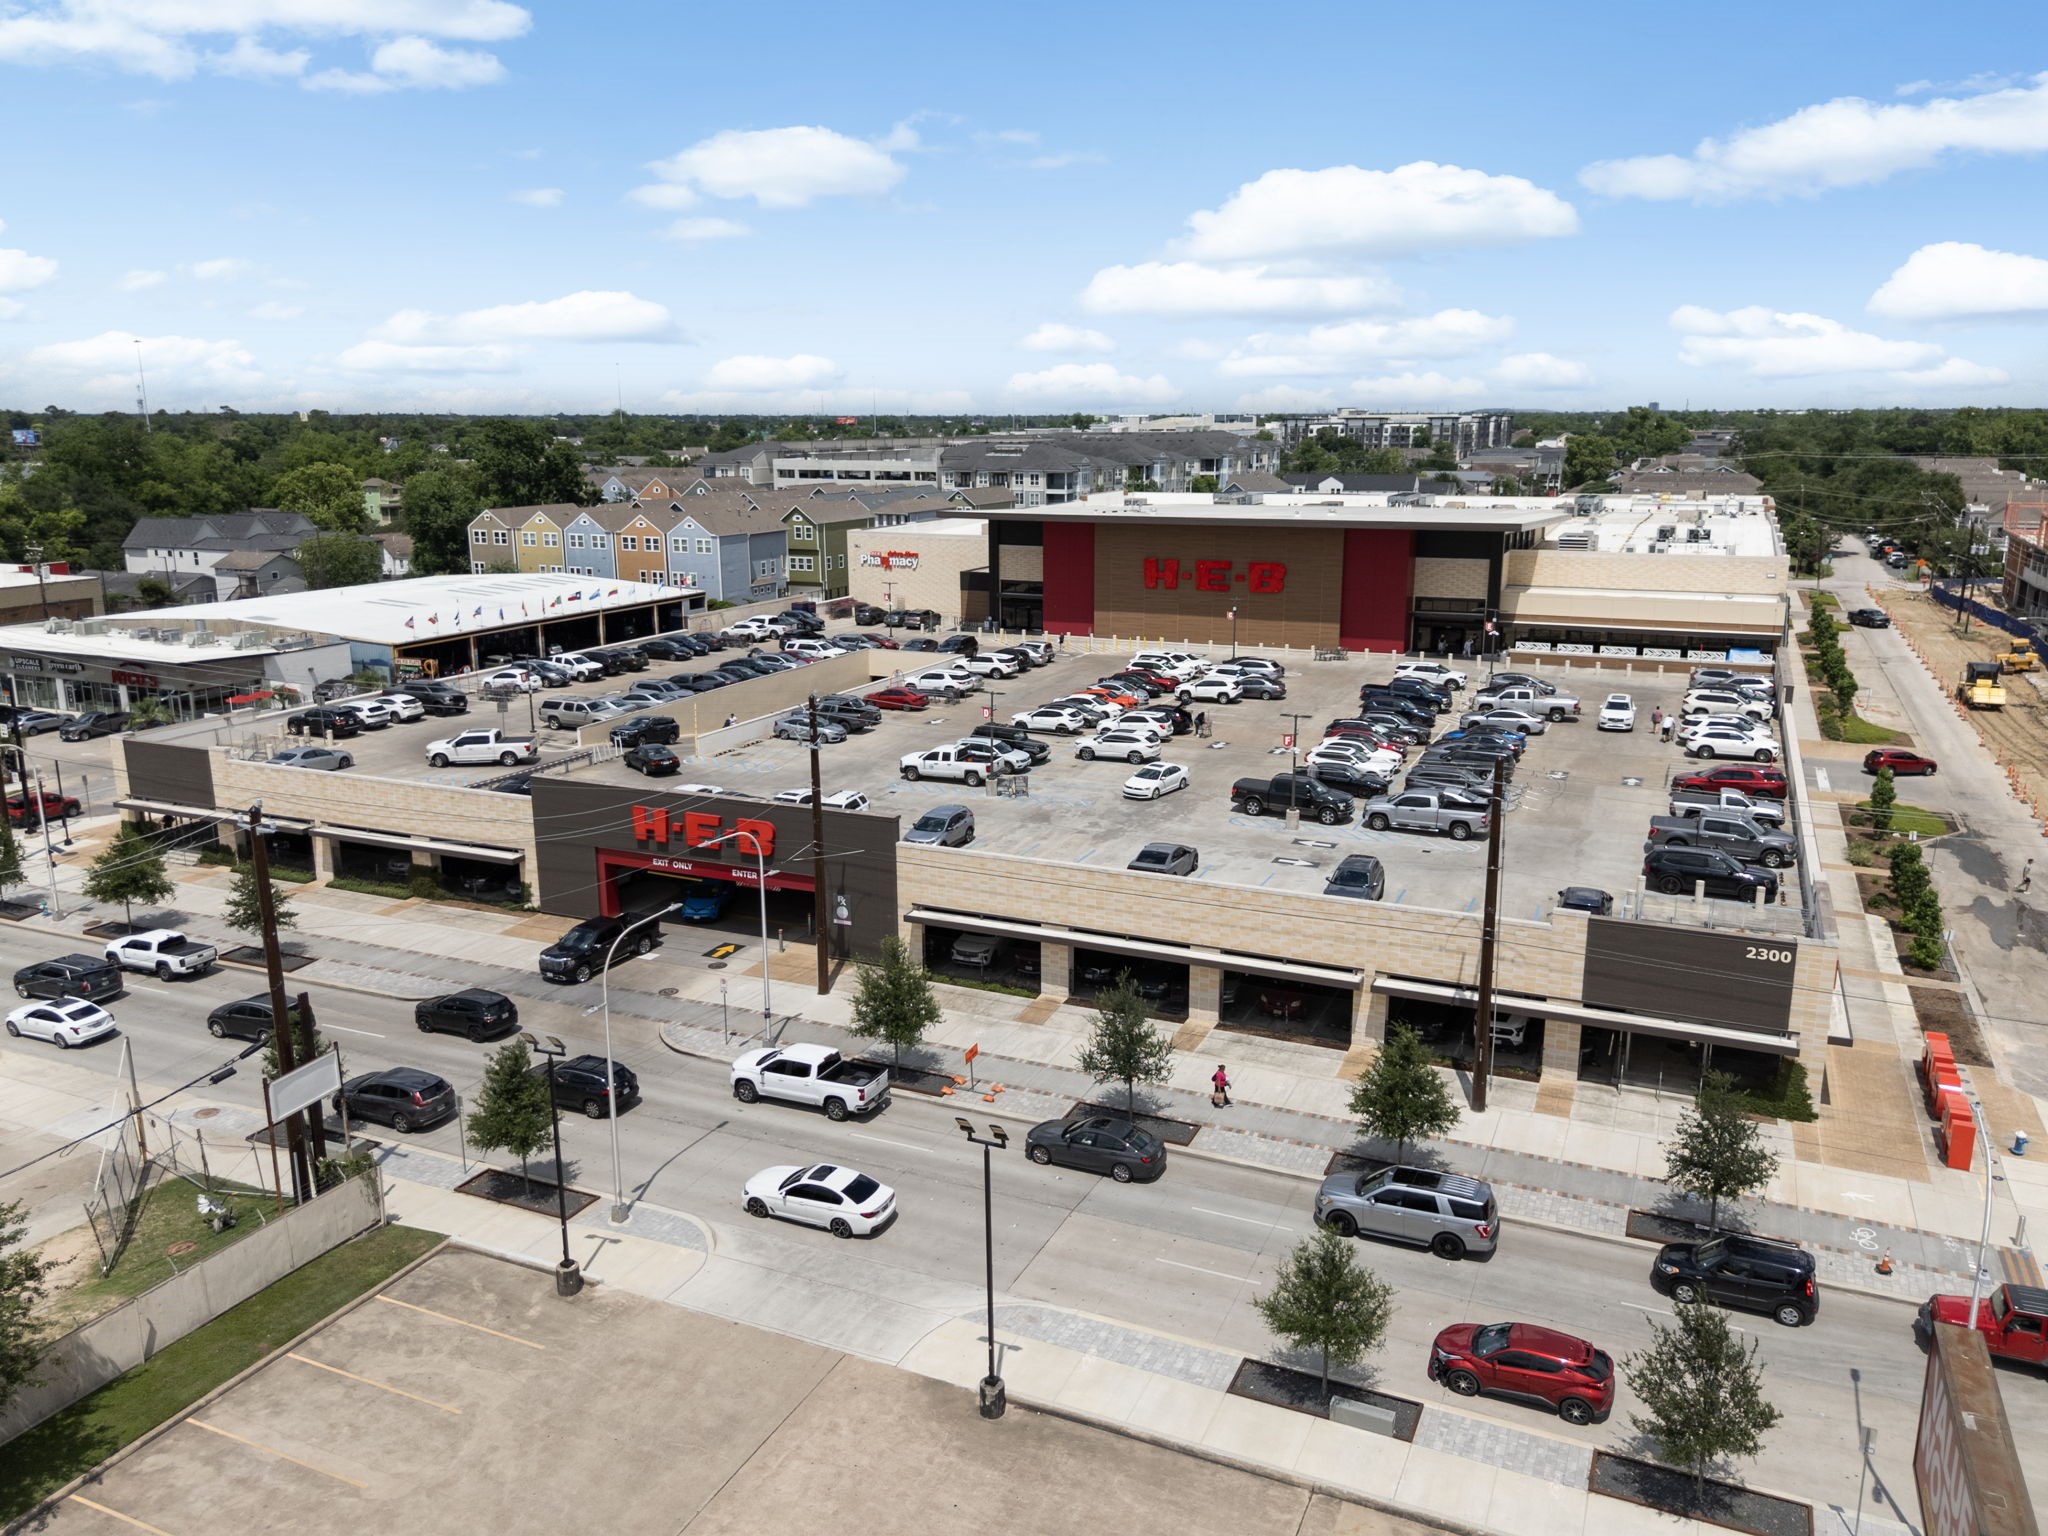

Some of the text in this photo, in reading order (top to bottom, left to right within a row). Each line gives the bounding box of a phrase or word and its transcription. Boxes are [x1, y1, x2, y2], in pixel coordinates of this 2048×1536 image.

[1143, 557, 1287, 594] H-E-B
[15, 657, 40, 665] UPSCALE
[633, 806, 775, 856] H-E-B
[652, 858, 693, 870] EXIT ONLY
[731, 869, 758, 879] ENTER
[1745, 946, 1792, 963] 2300
